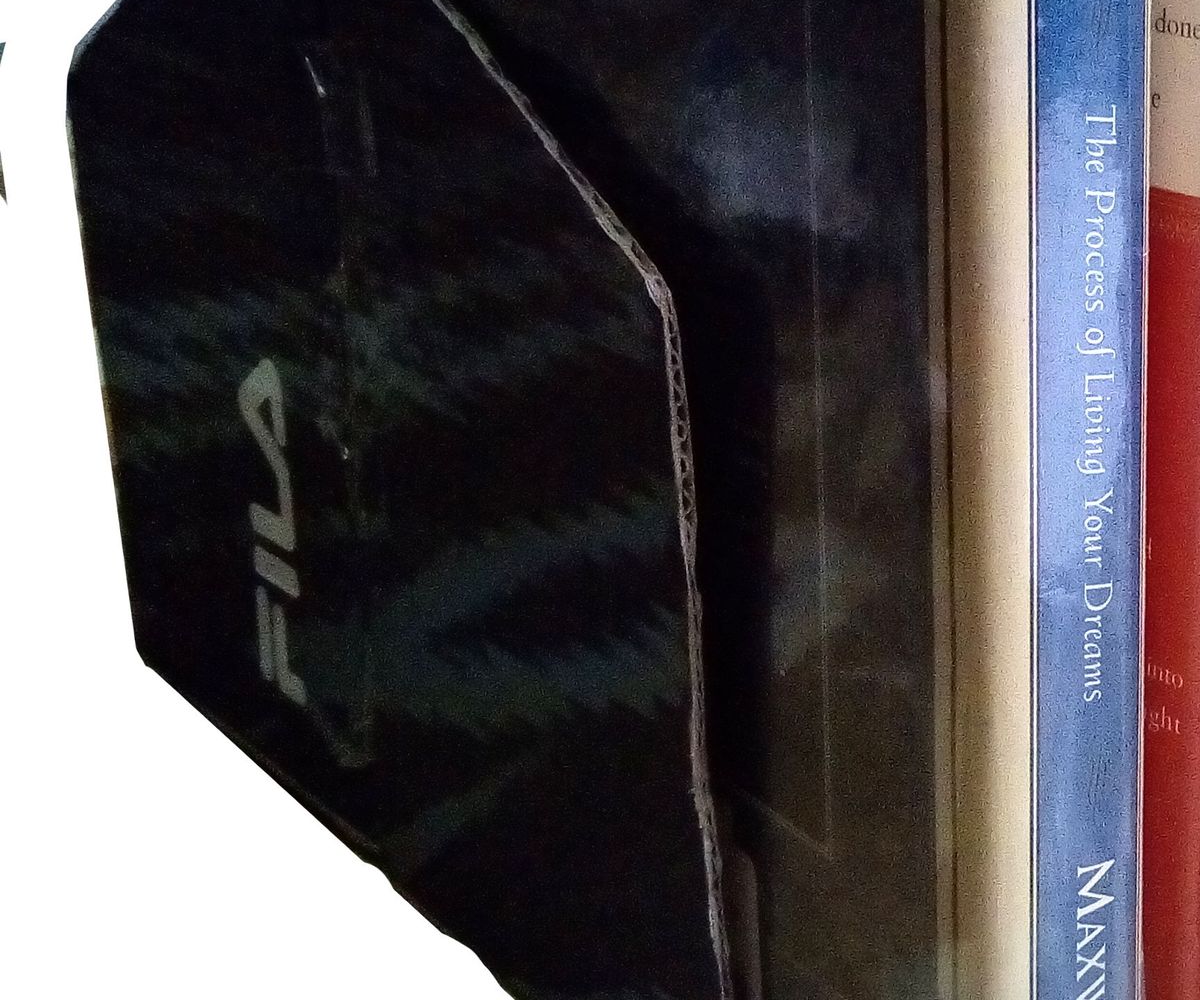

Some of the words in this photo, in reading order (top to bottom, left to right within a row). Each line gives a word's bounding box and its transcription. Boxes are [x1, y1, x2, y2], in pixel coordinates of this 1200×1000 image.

[1085, 103, 1117, 174] The
[1085, 190, 1117, 314] Process
[1075, 329, 1117, 359] of
[1076, 372, 1116, 476] Living
[238, 357, 308, 707] FILA
[1084, 487, 1115, 567] Your
[1083, 580, 1114, 702] Dreams
